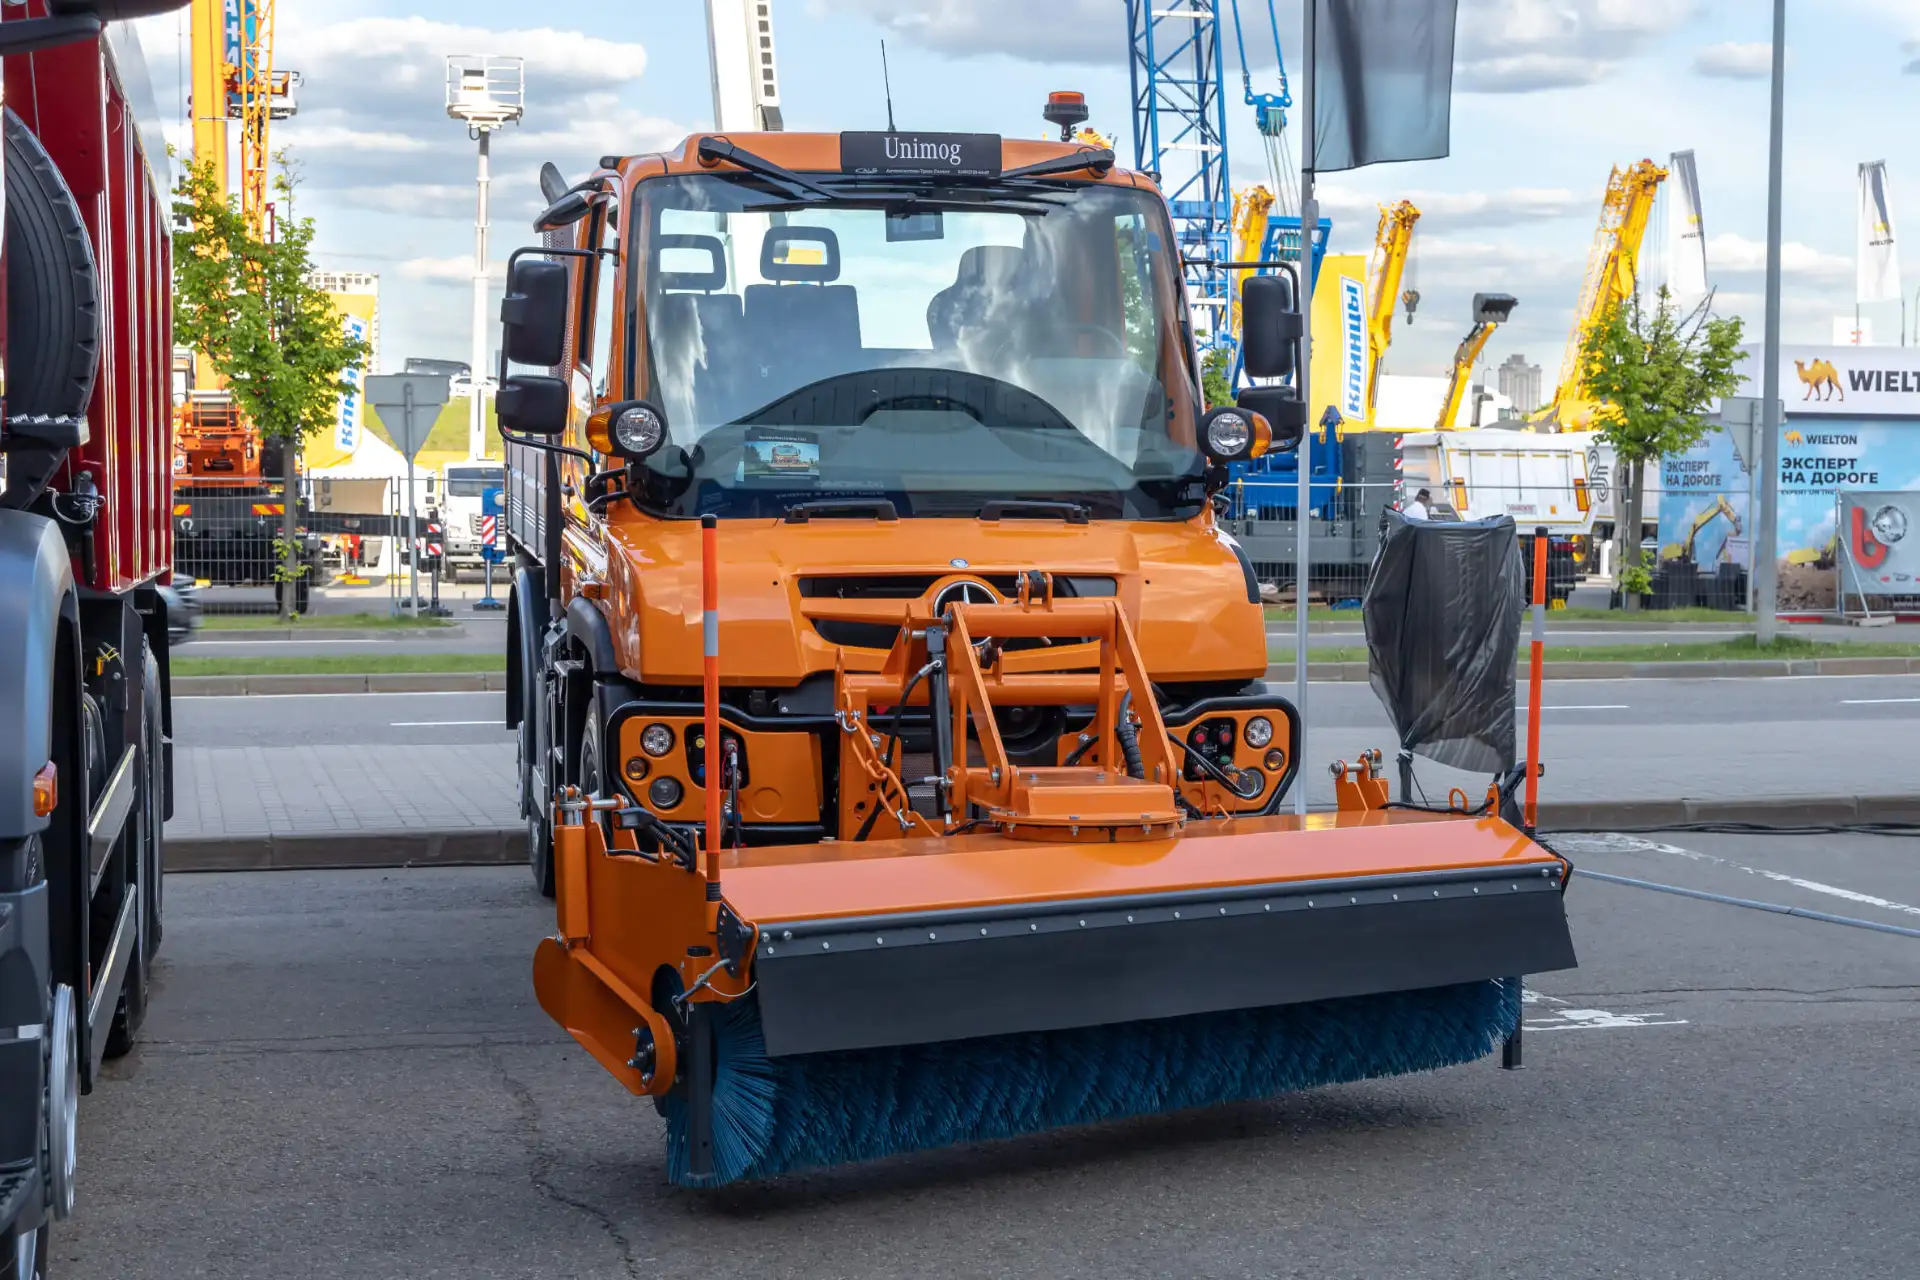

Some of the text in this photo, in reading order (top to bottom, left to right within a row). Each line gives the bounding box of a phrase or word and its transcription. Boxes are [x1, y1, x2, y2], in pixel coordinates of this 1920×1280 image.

[884, 136, 962, 166] Unimog
[1346, 284, 1362, 413] КЛИНЦЫ
[1806, 434, 1858, 445] WIELTON
[1666, 460, 1710, 473] ЭКСПЕРТ
[1782, 457, 1858, 470] ЭКСПЕРТ
[1666, 474, 1722, 488] НА ДОРОГЕ
[1781, 472, 1879, 486] НА ДОРОГЕ
